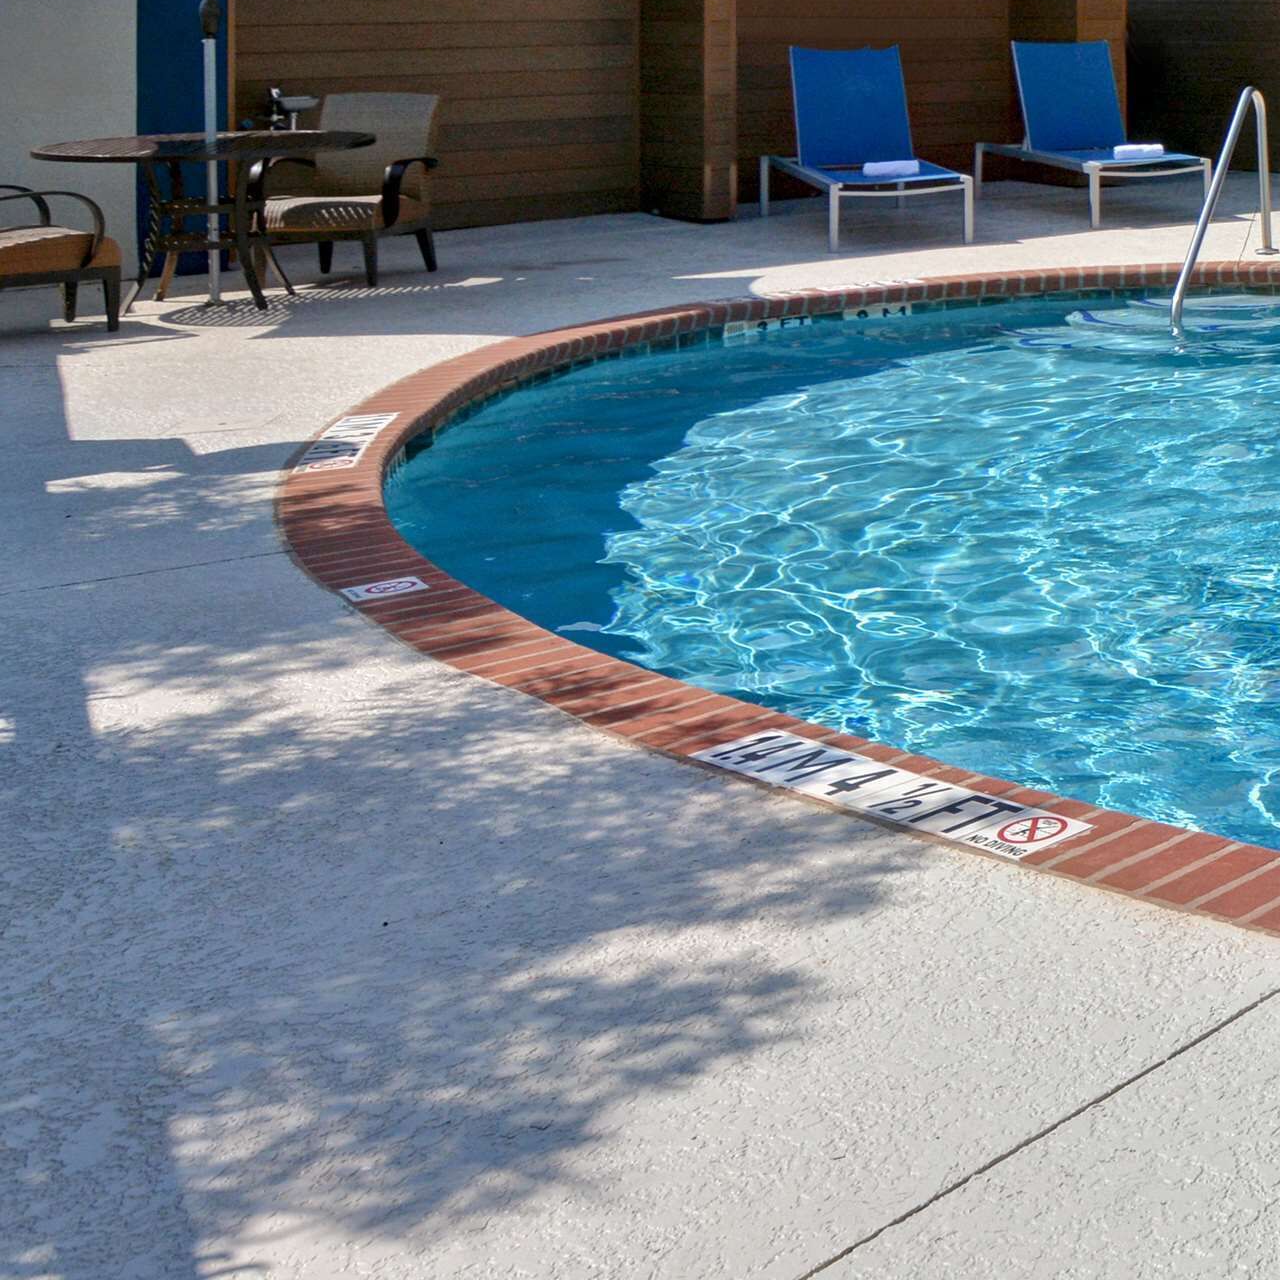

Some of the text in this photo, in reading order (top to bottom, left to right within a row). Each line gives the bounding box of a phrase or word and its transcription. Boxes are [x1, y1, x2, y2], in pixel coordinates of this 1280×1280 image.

[711, 735, 804, 765] 1.4
[754, 749, 857, 782] M
[824, 769, 898, 795] 4
[908, 794, 1025, 833] FT
[965, 834, 1028, 856] NO DIVING
